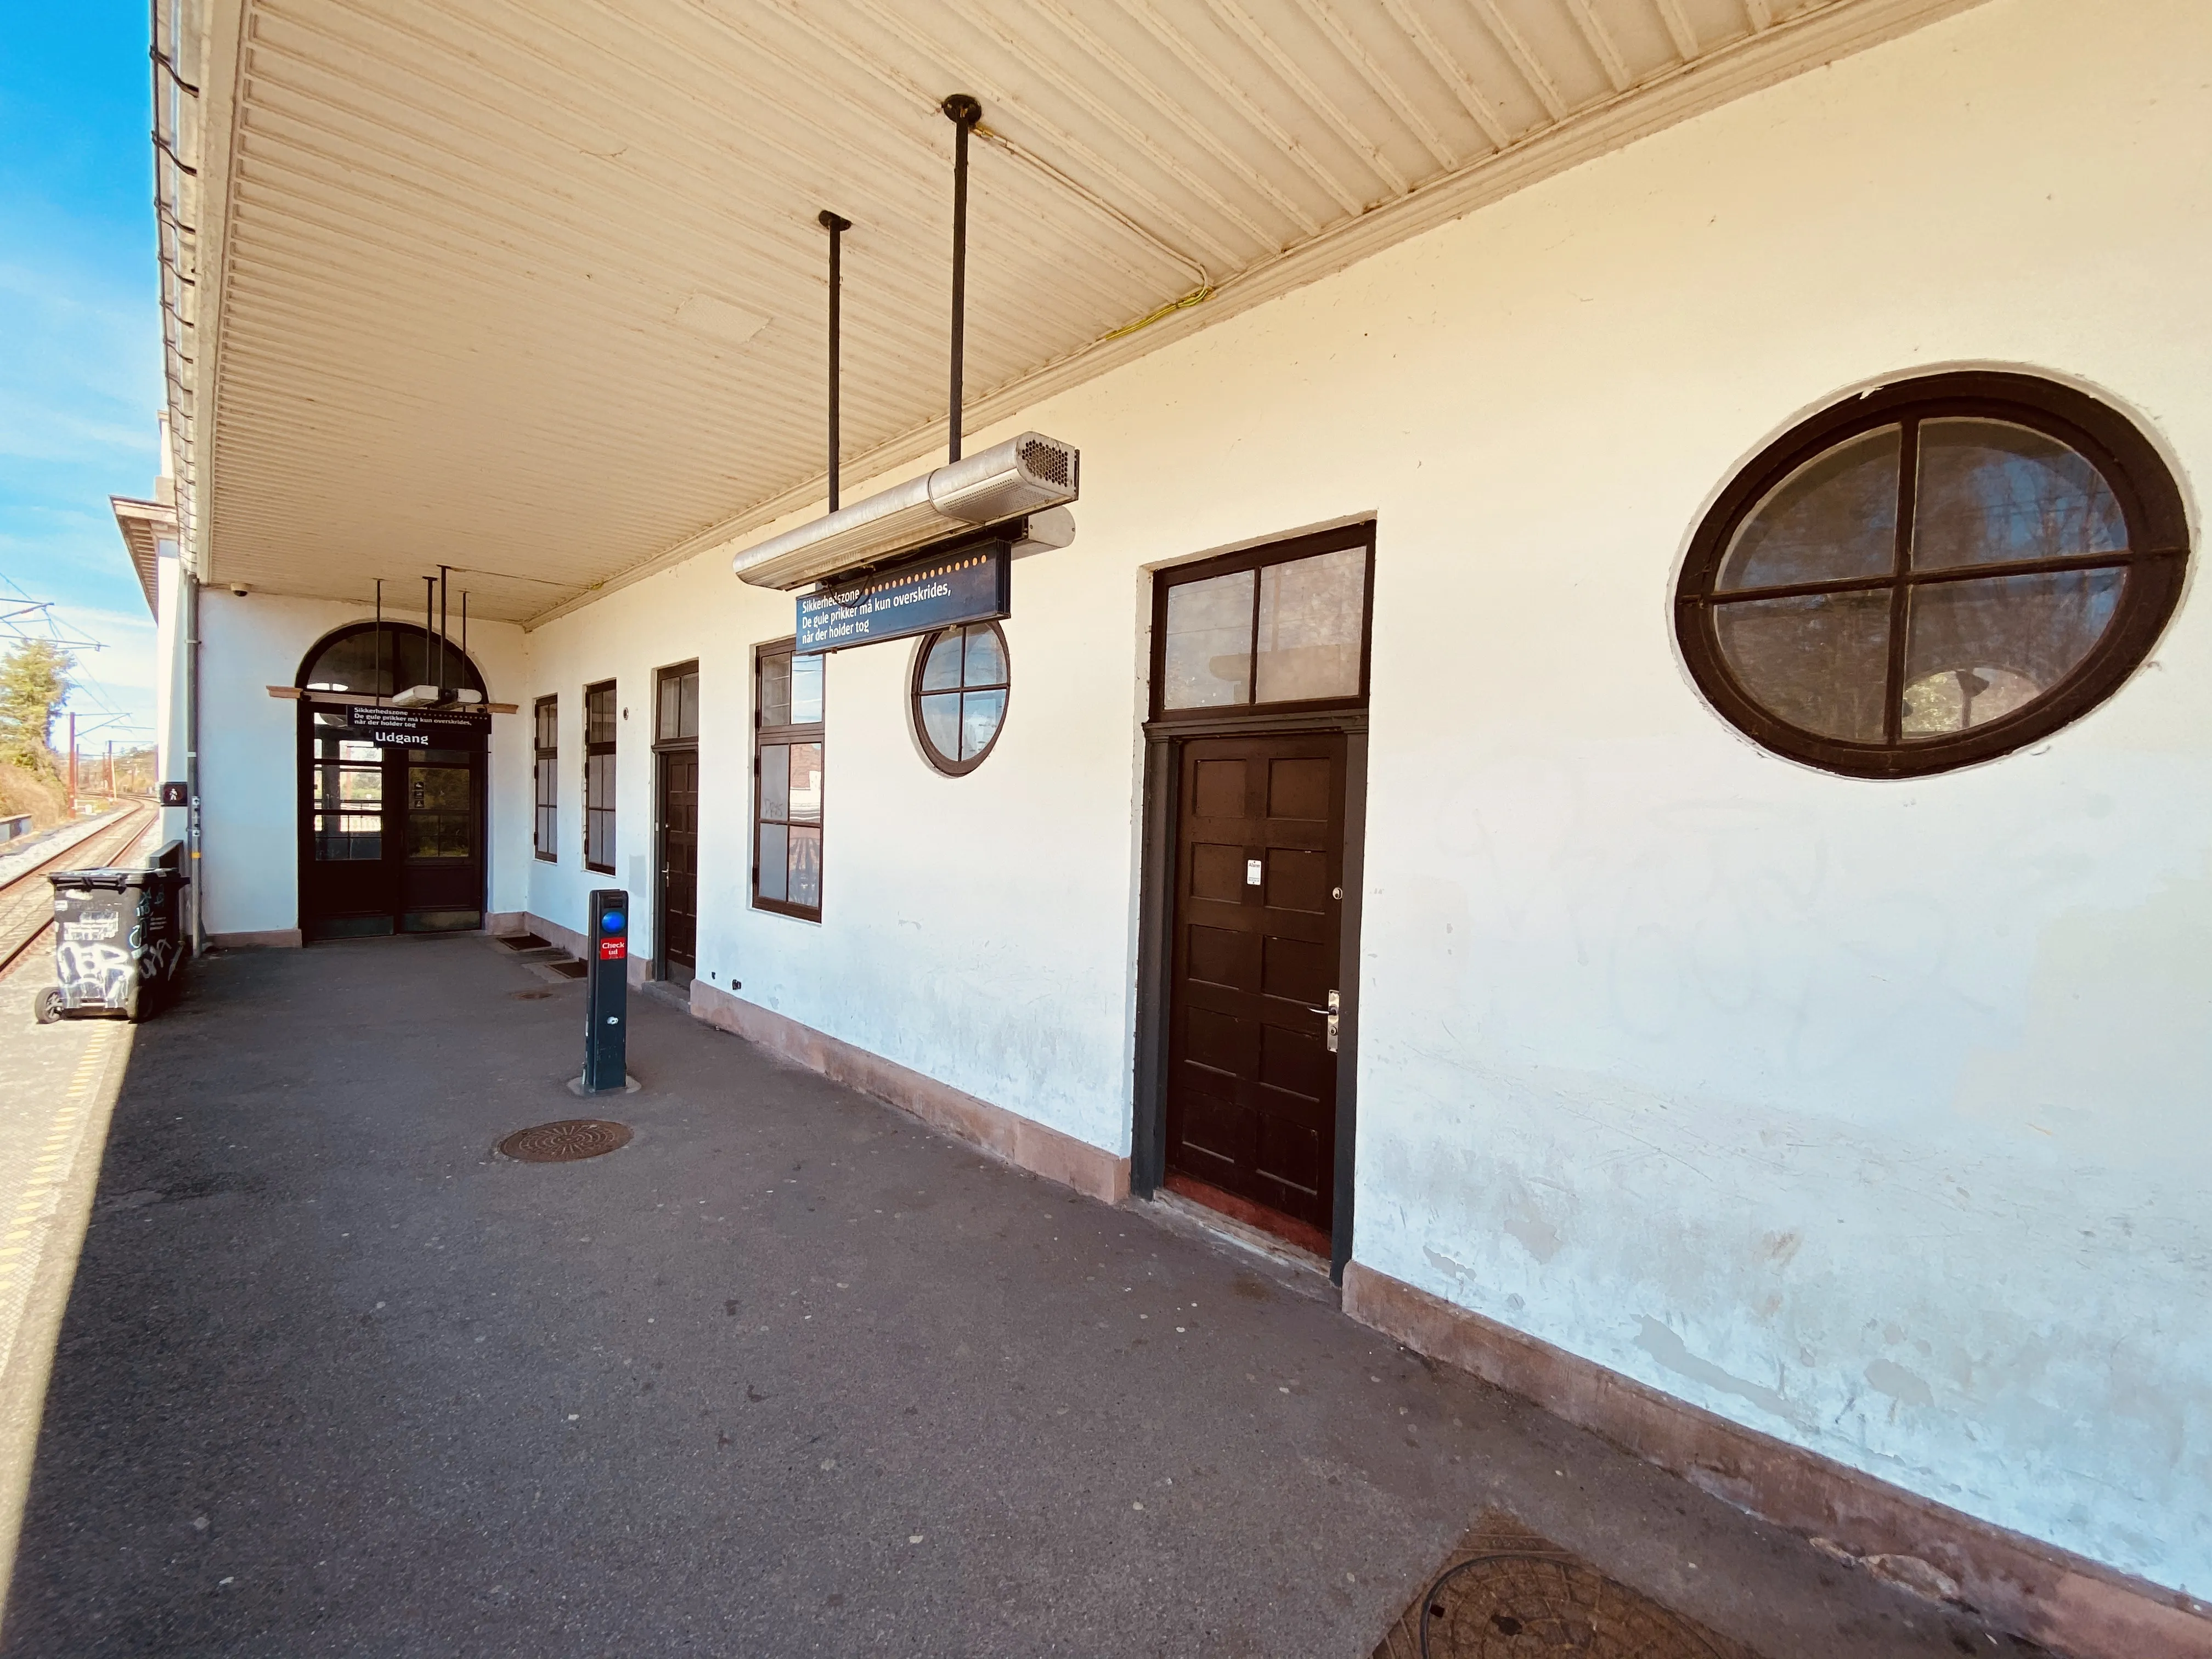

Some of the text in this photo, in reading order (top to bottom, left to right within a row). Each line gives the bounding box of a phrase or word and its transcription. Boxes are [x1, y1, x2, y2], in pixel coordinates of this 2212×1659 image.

[802, 589, 860, 614] Sikkerhedszone
[802, 582, 951, 629] De gule prikker må kun overskrides,
[802, 619, 870, 644] når der holder tog
[354, 707, 408, 715] Sikkerhedszone
[375, 731, 428, 745] Udgang
